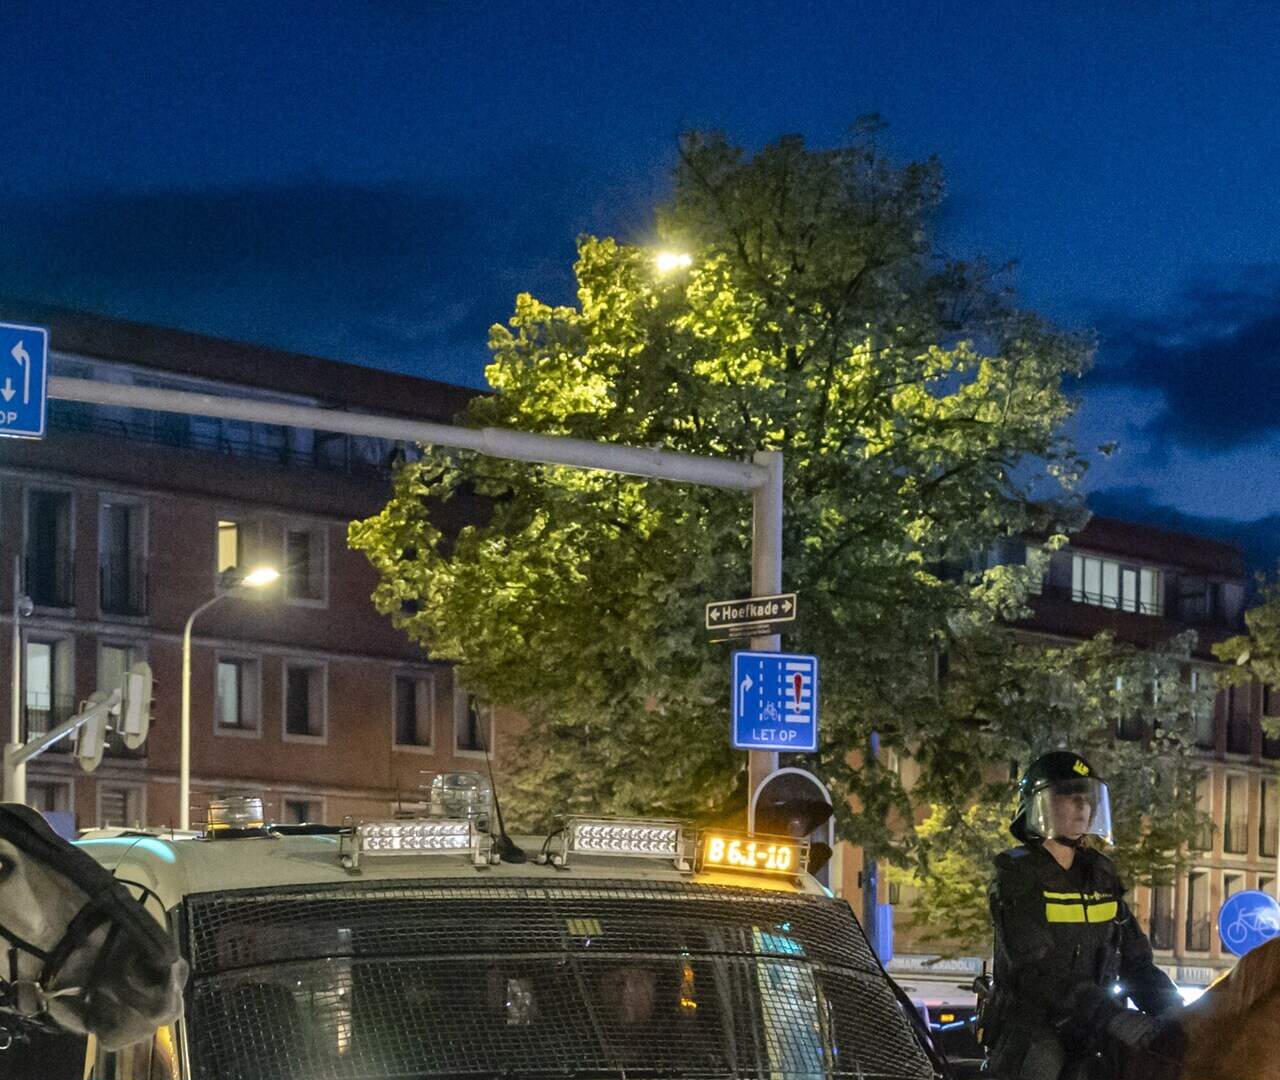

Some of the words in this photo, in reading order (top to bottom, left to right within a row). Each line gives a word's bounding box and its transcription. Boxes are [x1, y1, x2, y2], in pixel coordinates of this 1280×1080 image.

[722, 601, 779, 620] Hoefkade
[752, 728, 776, 741] LET
[779, 729, 797, 741] OP
